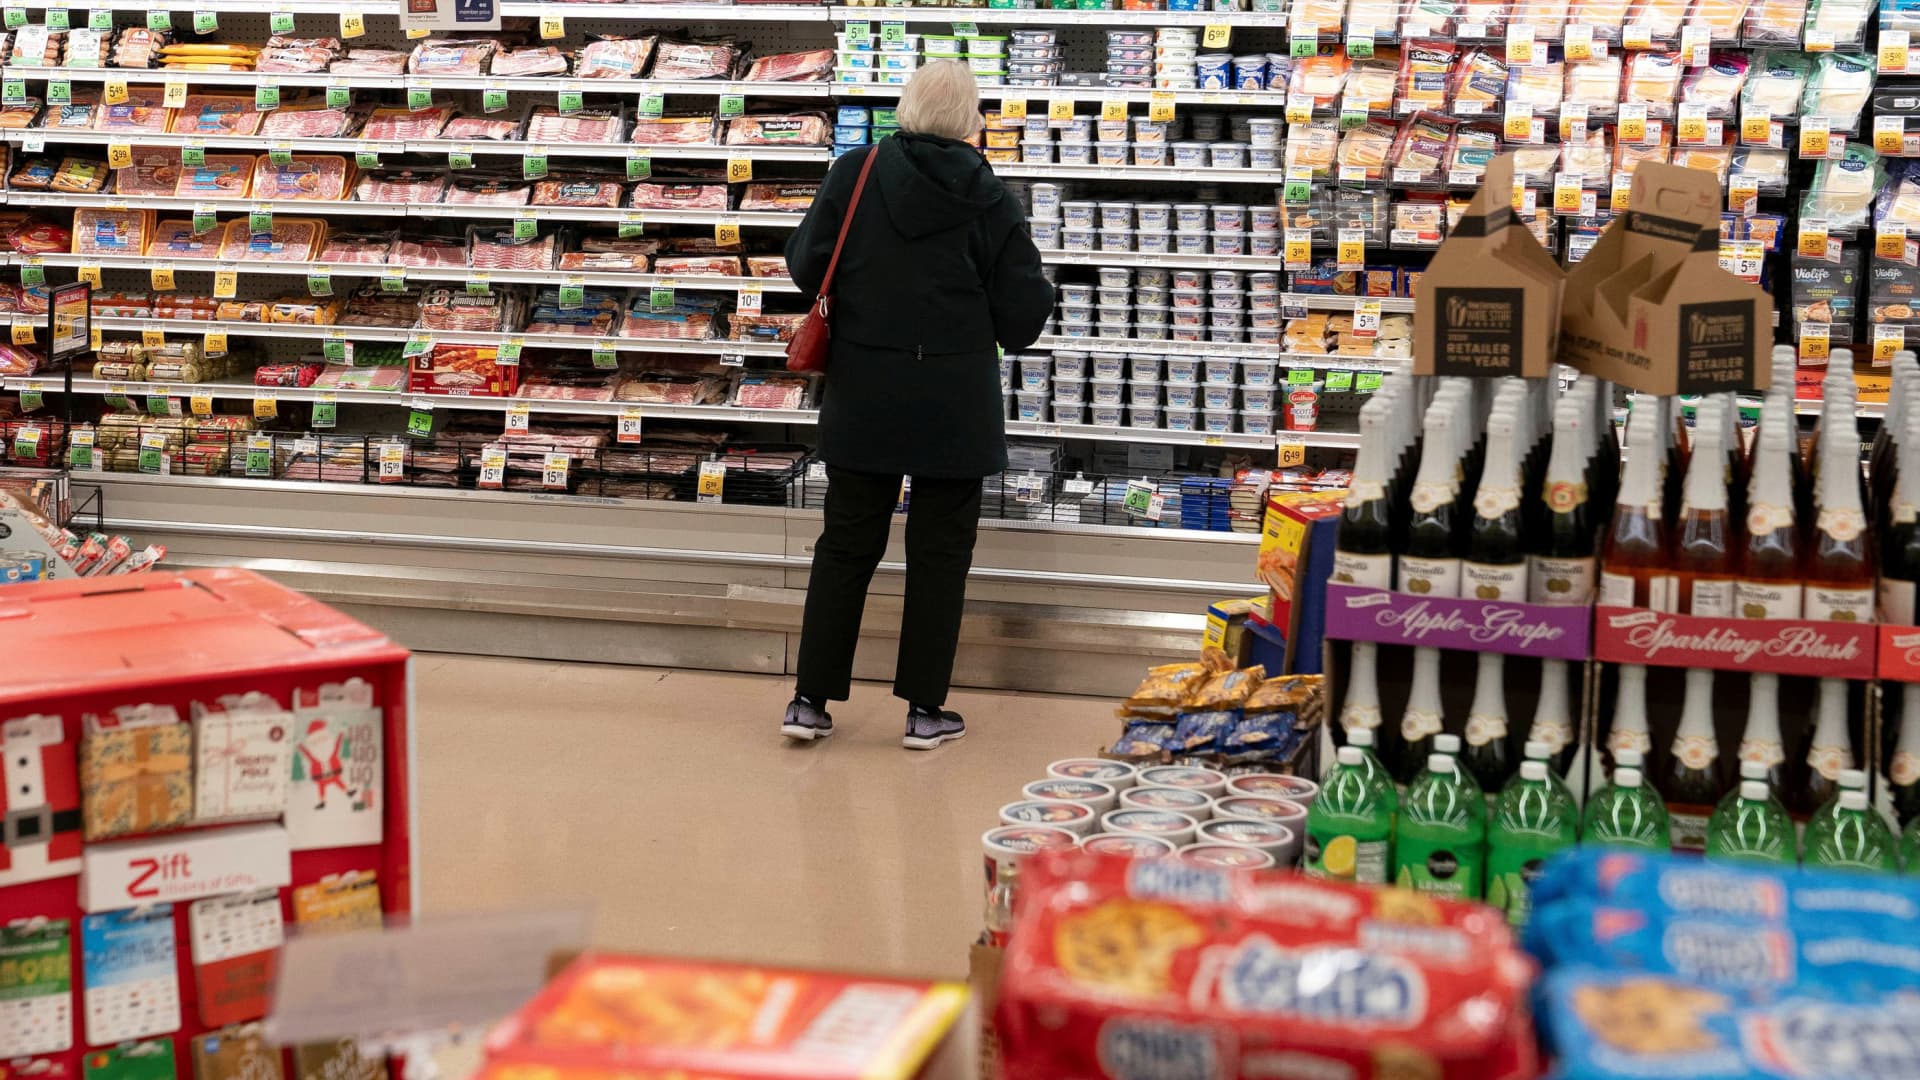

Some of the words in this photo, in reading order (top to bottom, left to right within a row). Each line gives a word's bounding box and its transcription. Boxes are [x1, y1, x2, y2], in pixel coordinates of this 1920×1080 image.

[1794, 268, 1831, 282] Violife
[1874, 268, 1904, 280] Violife
[450, 296, 476, 306] Jimmy
[1446, 343, 1511, 355] RETAILER
[1473, 355, 1510, 368] YEAR
[1687, 357, 1744, 372] RETAILER
[1711, 369, 1744, 382] YEAR
[1625, 617, 1762, 665] Sparkling
[1763, 627, 1862, 661] Blush
[127, 852, 192, 898] Zift
